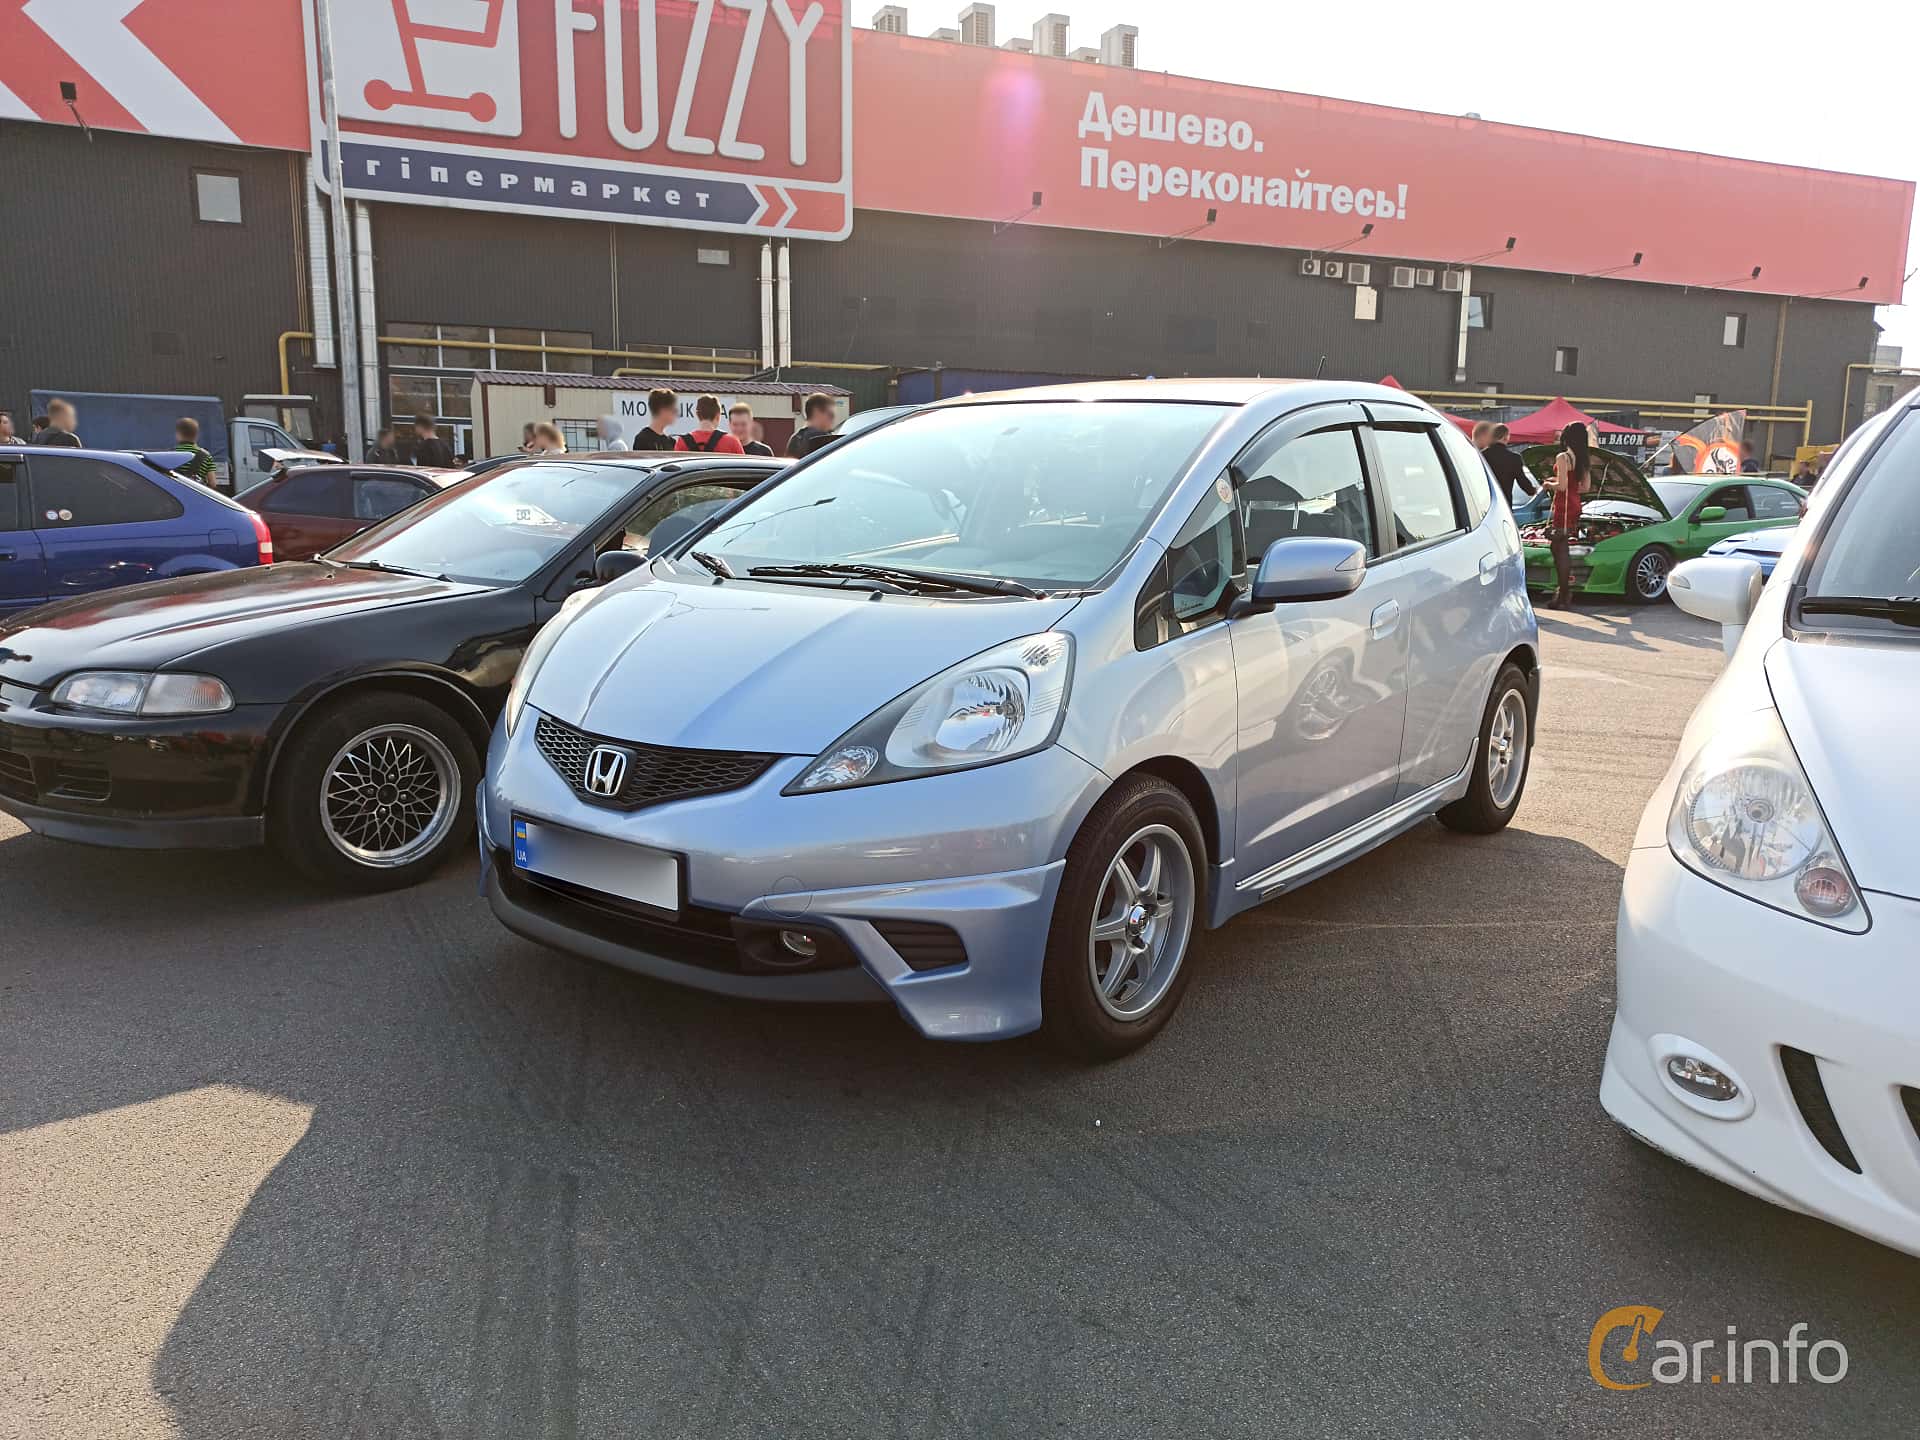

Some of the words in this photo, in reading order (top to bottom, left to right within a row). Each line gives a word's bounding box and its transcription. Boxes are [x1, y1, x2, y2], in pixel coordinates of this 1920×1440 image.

[1078, 91, 1264, 152] Дешево.
[366, 157, 710, 208] гіпермаркет
[1080, 146, 1408, 220] Переконайтесь!
[516, 849, 527, 863] UA
